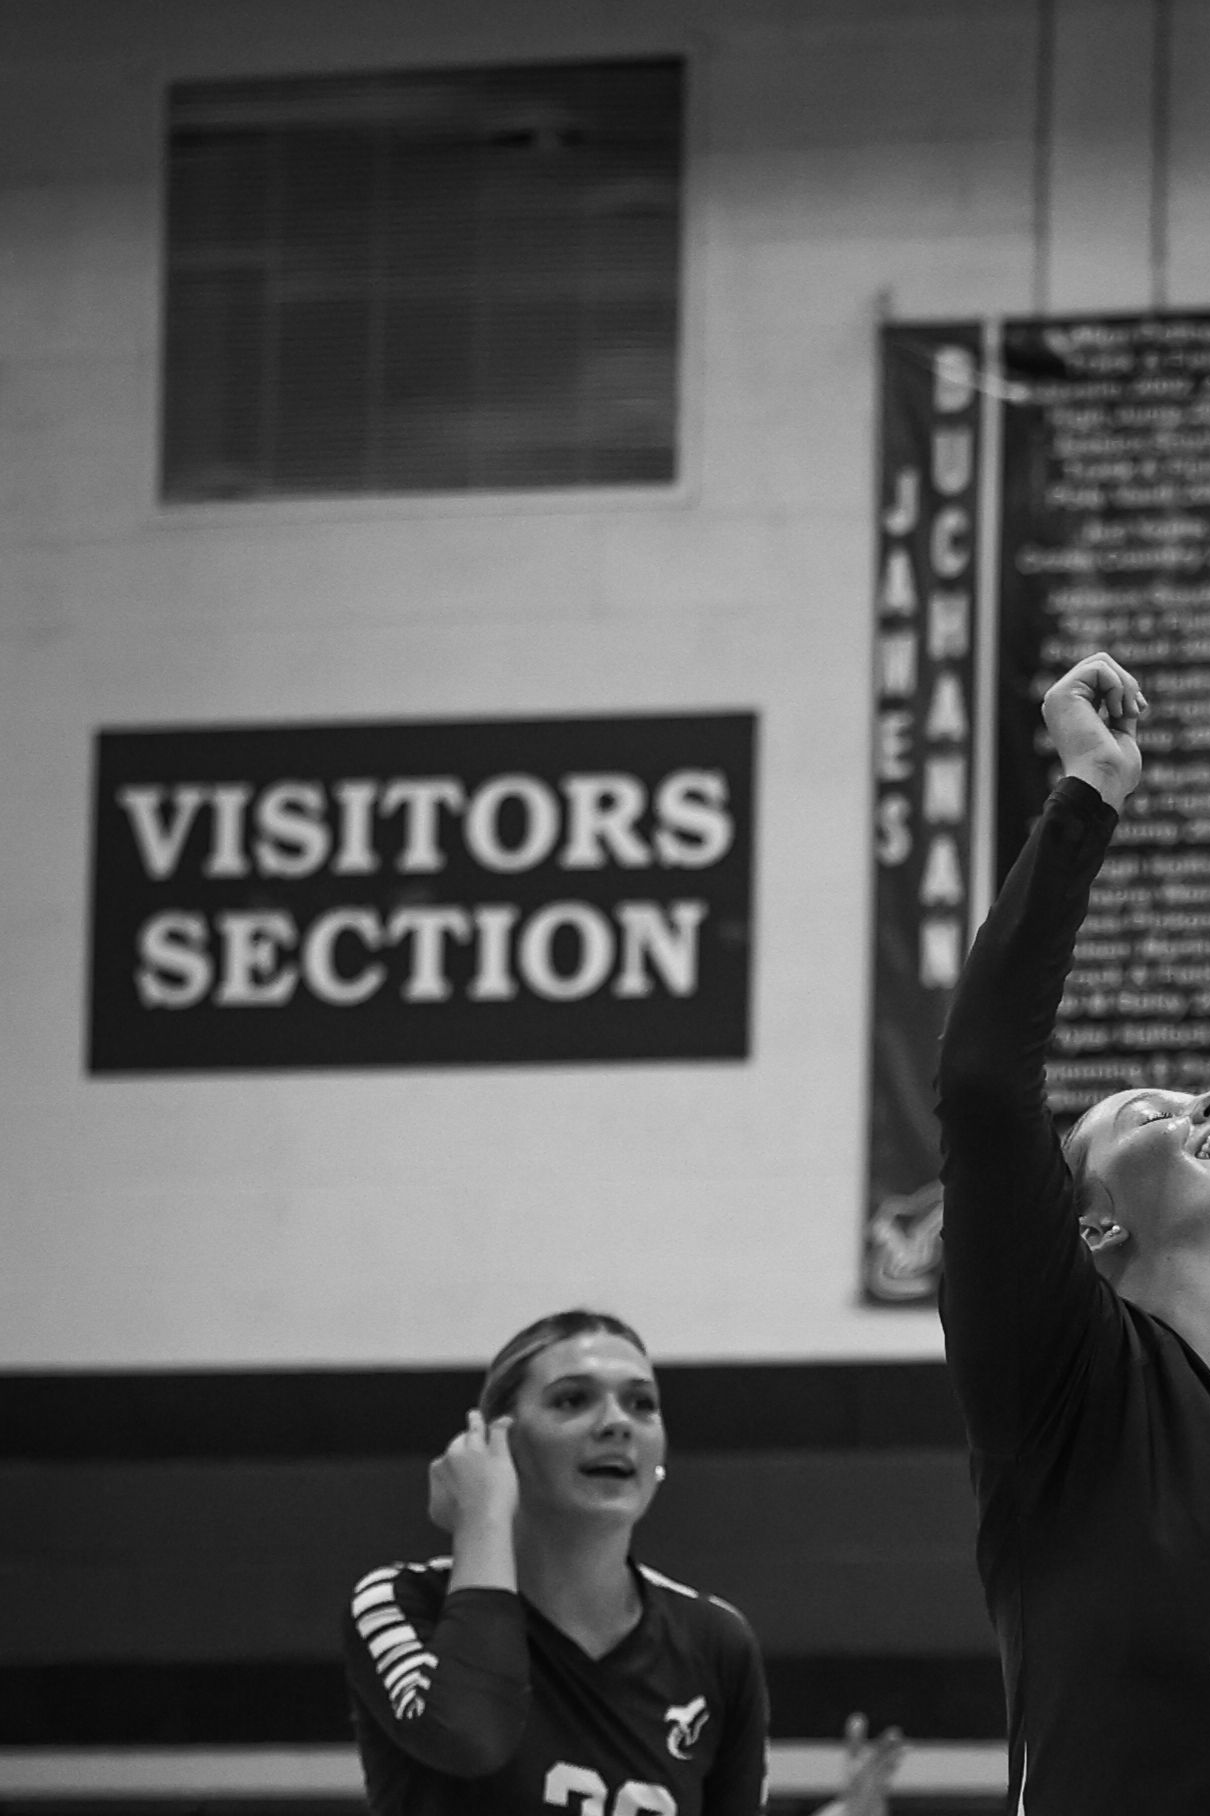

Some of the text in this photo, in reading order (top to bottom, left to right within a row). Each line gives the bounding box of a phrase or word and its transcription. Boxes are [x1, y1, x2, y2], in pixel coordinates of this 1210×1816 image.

[876, 468, 920, 866] JAMES
[918, 345, 976, 989] BUCHANAN
[117, 768, 734, 880] VISITORS
[136, 901, 709, 1010] SECTION
